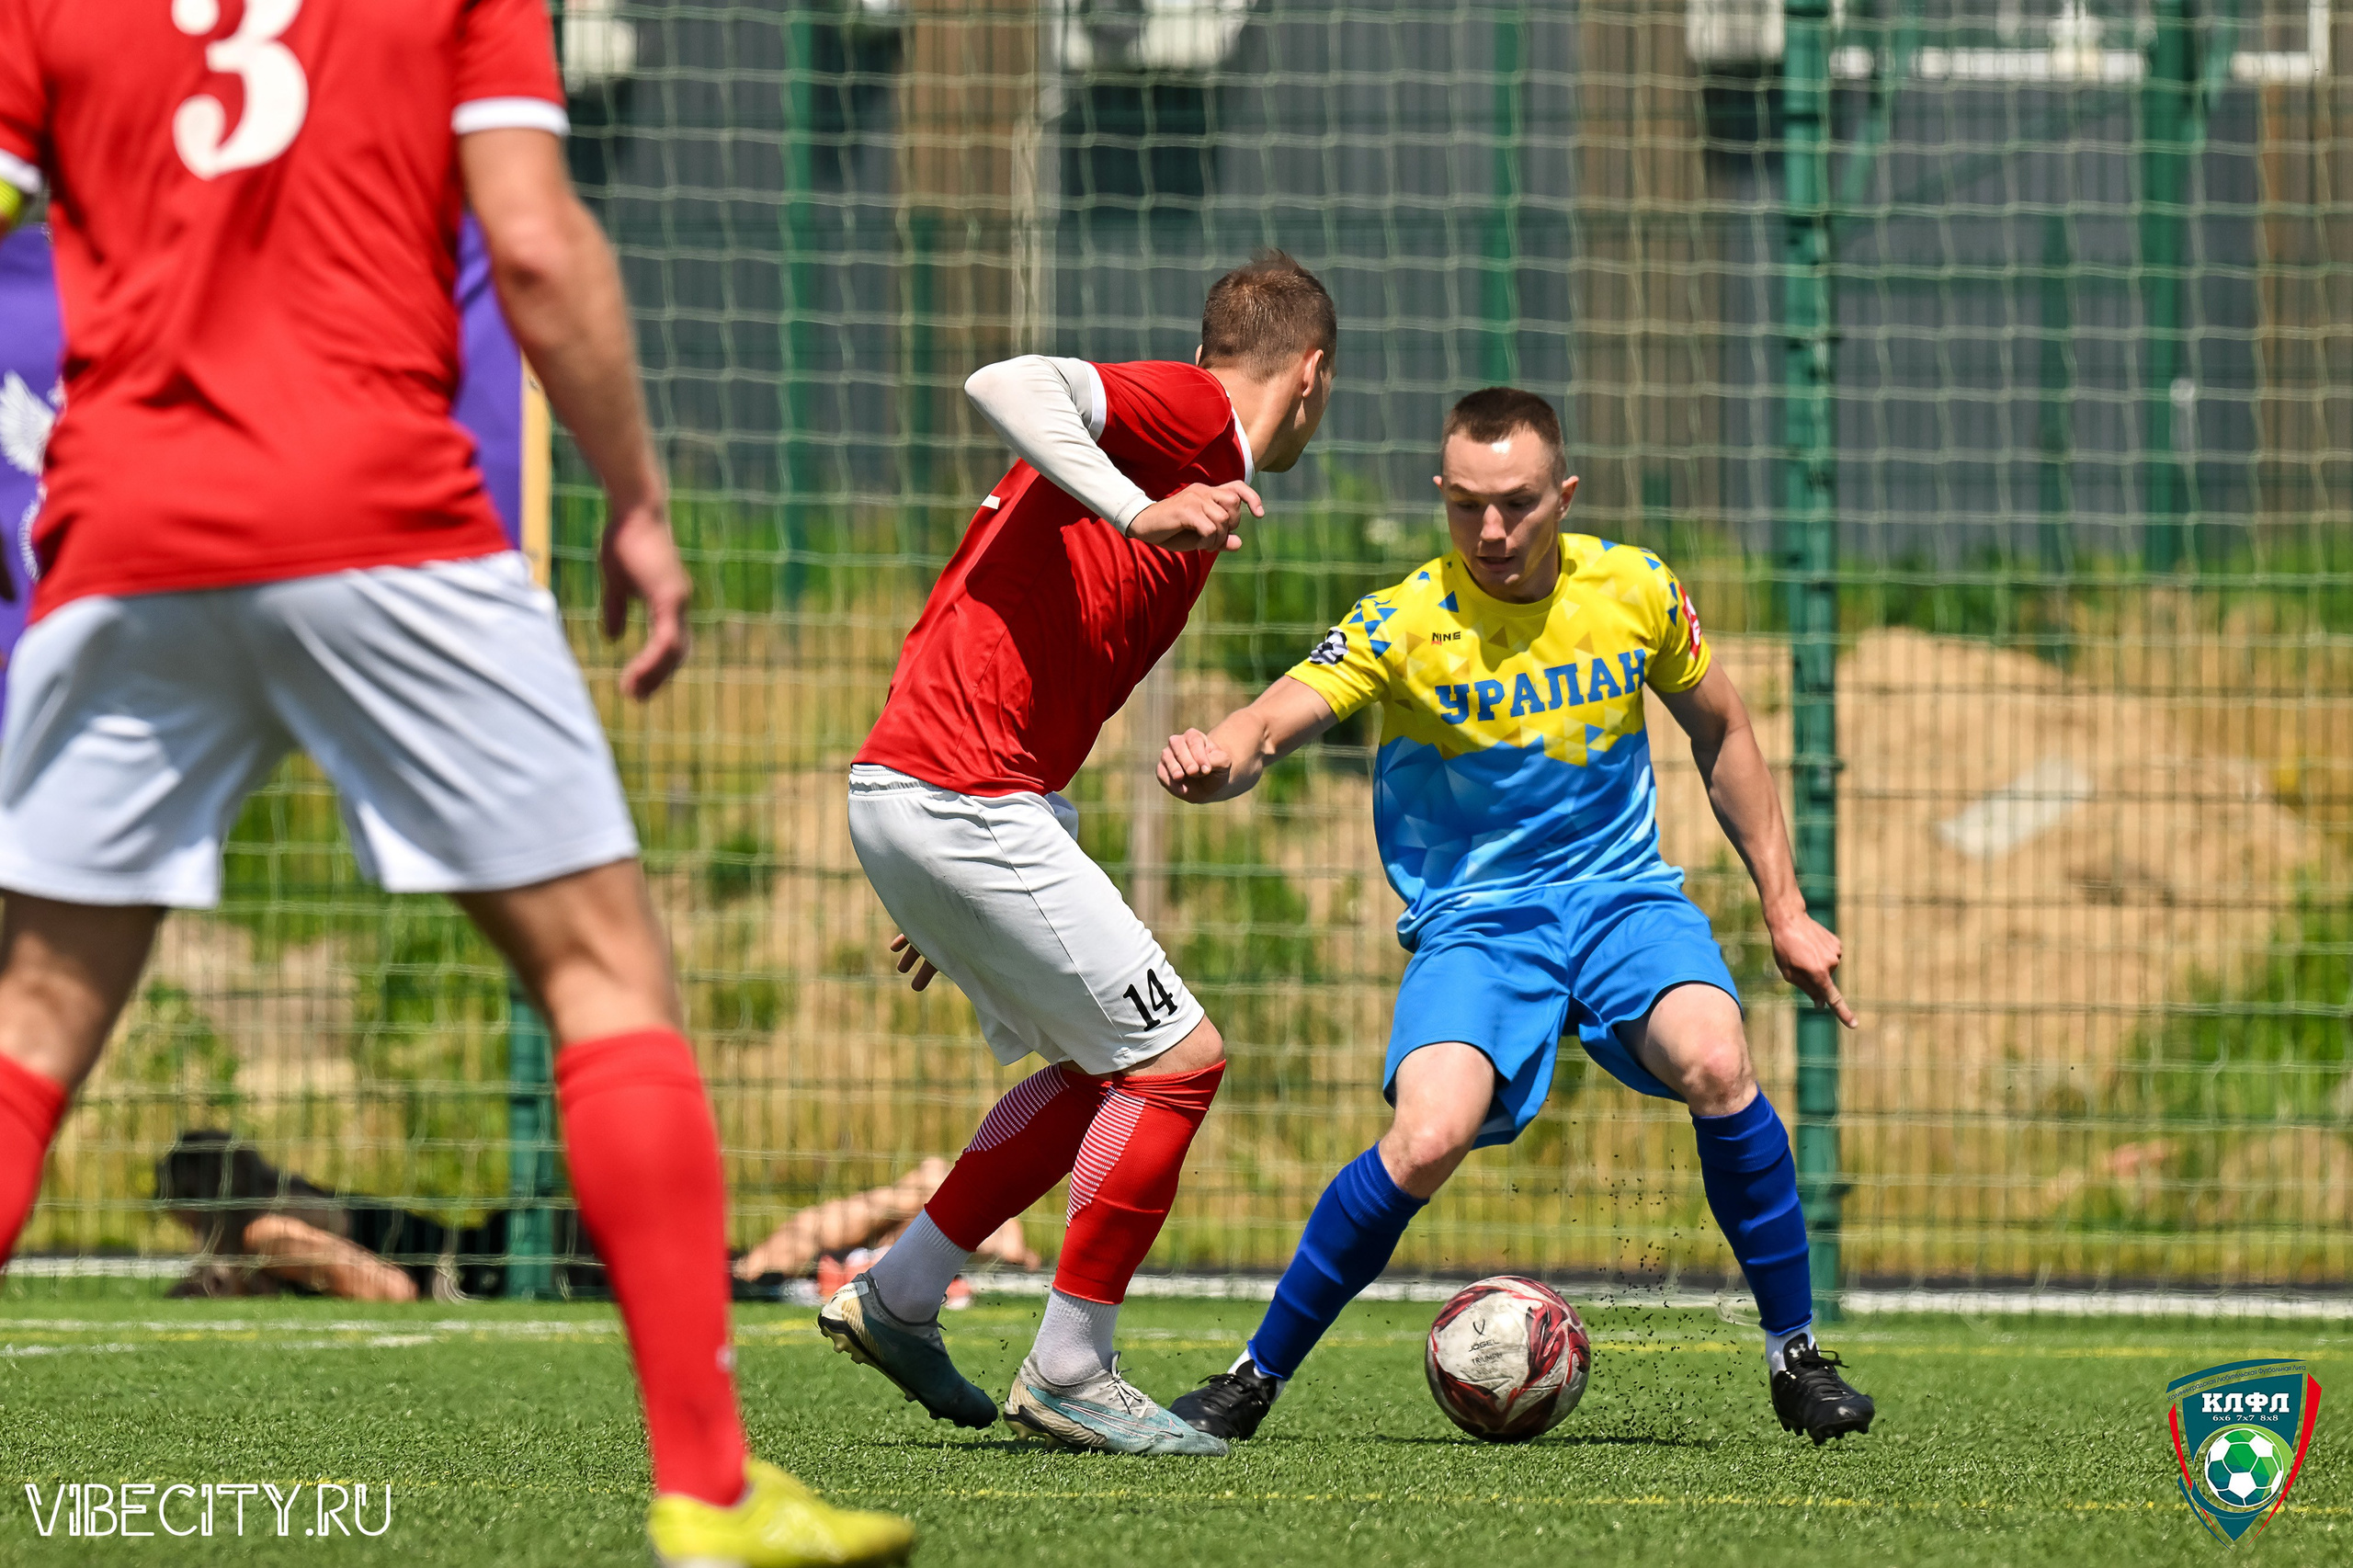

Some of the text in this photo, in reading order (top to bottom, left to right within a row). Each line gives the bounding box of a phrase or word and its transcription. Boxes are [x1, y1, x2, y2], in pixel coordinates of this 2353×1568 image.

[171, 0, 309, 181] 3
[1432, 631, 1461, 642] NINE
[1435, 649, 1646, 725] УРАЛАН
[1123, 968, 1177, 1032] 14
